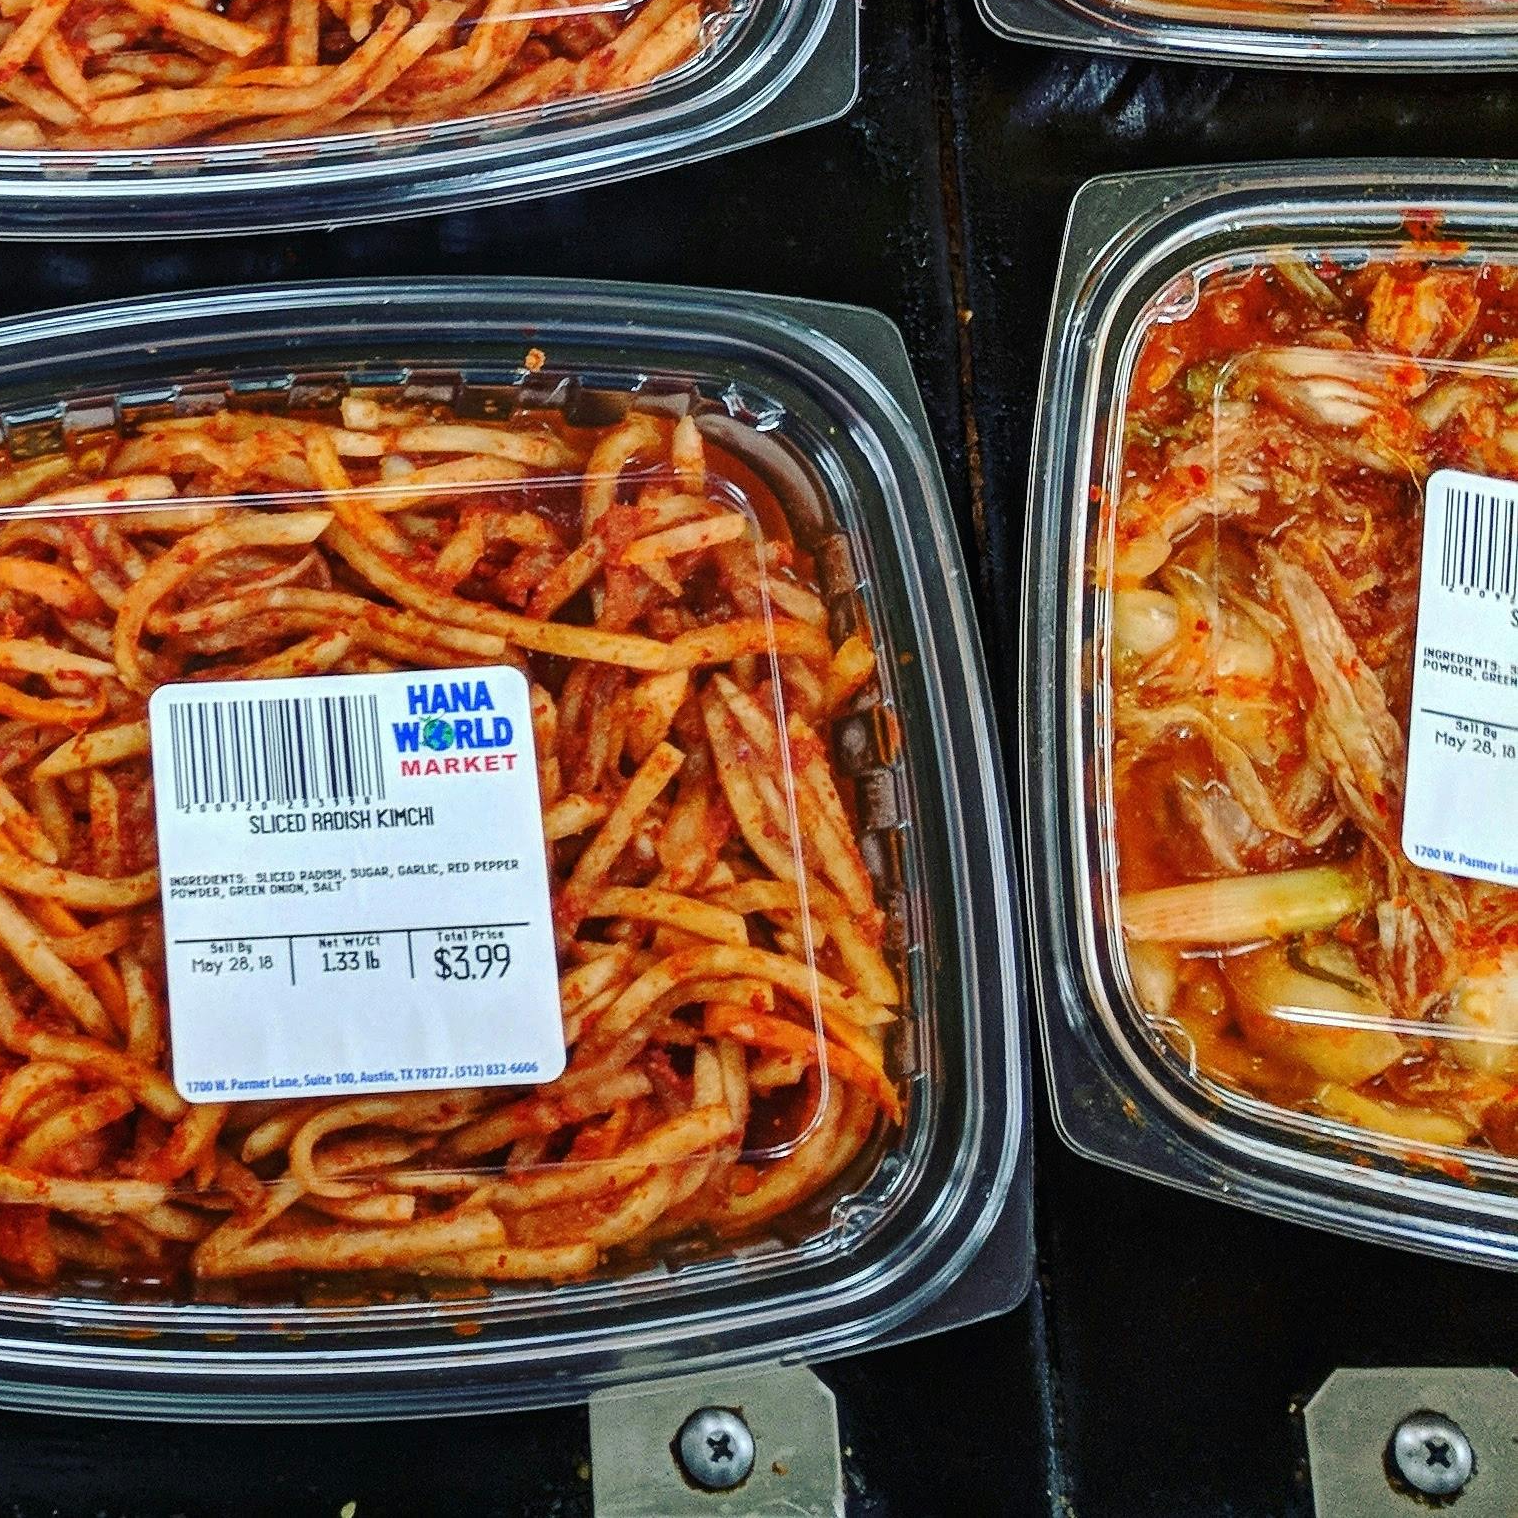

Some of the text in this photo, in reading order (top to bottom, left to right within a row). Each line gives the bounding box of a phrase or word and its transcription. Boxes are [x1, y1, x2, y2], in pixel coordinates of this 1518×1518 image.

[1481, 670, 1518, 689] GREEN
[406, 680, 495, 715] HANA
[391, 716, 514, 753] WORLD
[1434, 730, 1467, 752] May
[1501, 743, 1516, 759] 18
[400, 753, 518, 777] MARKET
[248, 805, 434, 834] SLICED RADISH KIMCHI
[1414, 844, 1441, 860] 1700
[1458, 852, 1499, 872] Parmer
[255, 870, 296, 883] SLICED
[446, 861, 470, 873] RED
[473, 858, 519, 872] PEPPER
[228, 884, 266, 897] GREEN
[312, 880, 342, 893] SALT
[318, 937, 338, 948] Net
[437, 929, 504, 942] Total Price
[210, 941, 252, 955] Sell By
[191, 958, 223, 975] May
[258, 954, 274, 970] 18
[322, 949, 380, 972] 1.33 lb
[433, 943, 511, 981] $3.99
[185, 1079, 214, 1093] 1700
[229, 1077, 271, 1091] Parmer
[303, 1073, 333, 1087] Suite
[399, 1067, 417, 1082] TX
[485, 1060, 539, 1076] 832-6606
